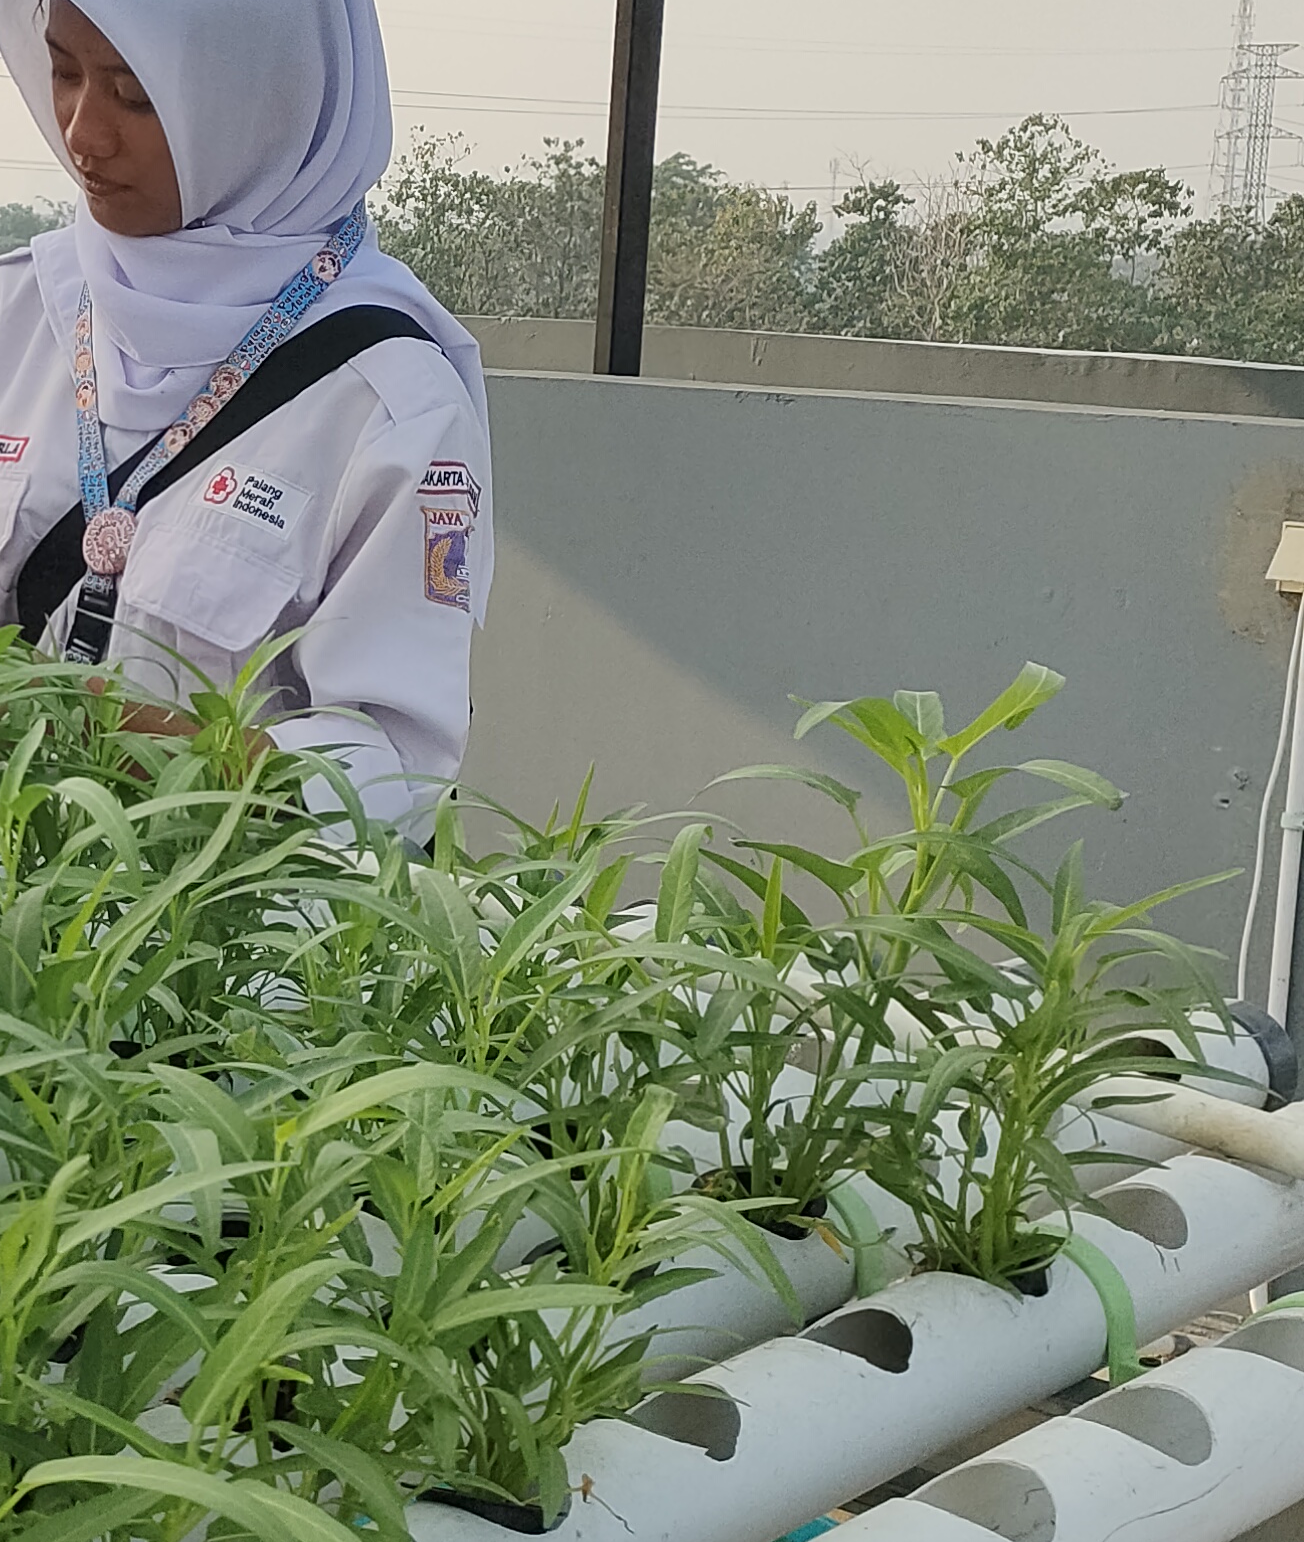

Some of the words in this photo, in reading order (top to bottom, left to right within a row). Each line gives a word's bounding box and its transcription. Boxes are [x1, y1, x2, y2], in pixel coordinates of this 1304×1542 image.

[277, 274, 309, 310] Palang
[285, 283, 316, 316] Merah
[239, 316, 272, 353] Palang
[247, 326, 279, 359] Merah
[244, 475, 284, 501] Palang
[420, 469, 464, 487] AKARTA
[238, 486, 275, 510] Merah
[232, 499, 286, 530] Indonesia
[429, 512, 464, 527] JAYA
